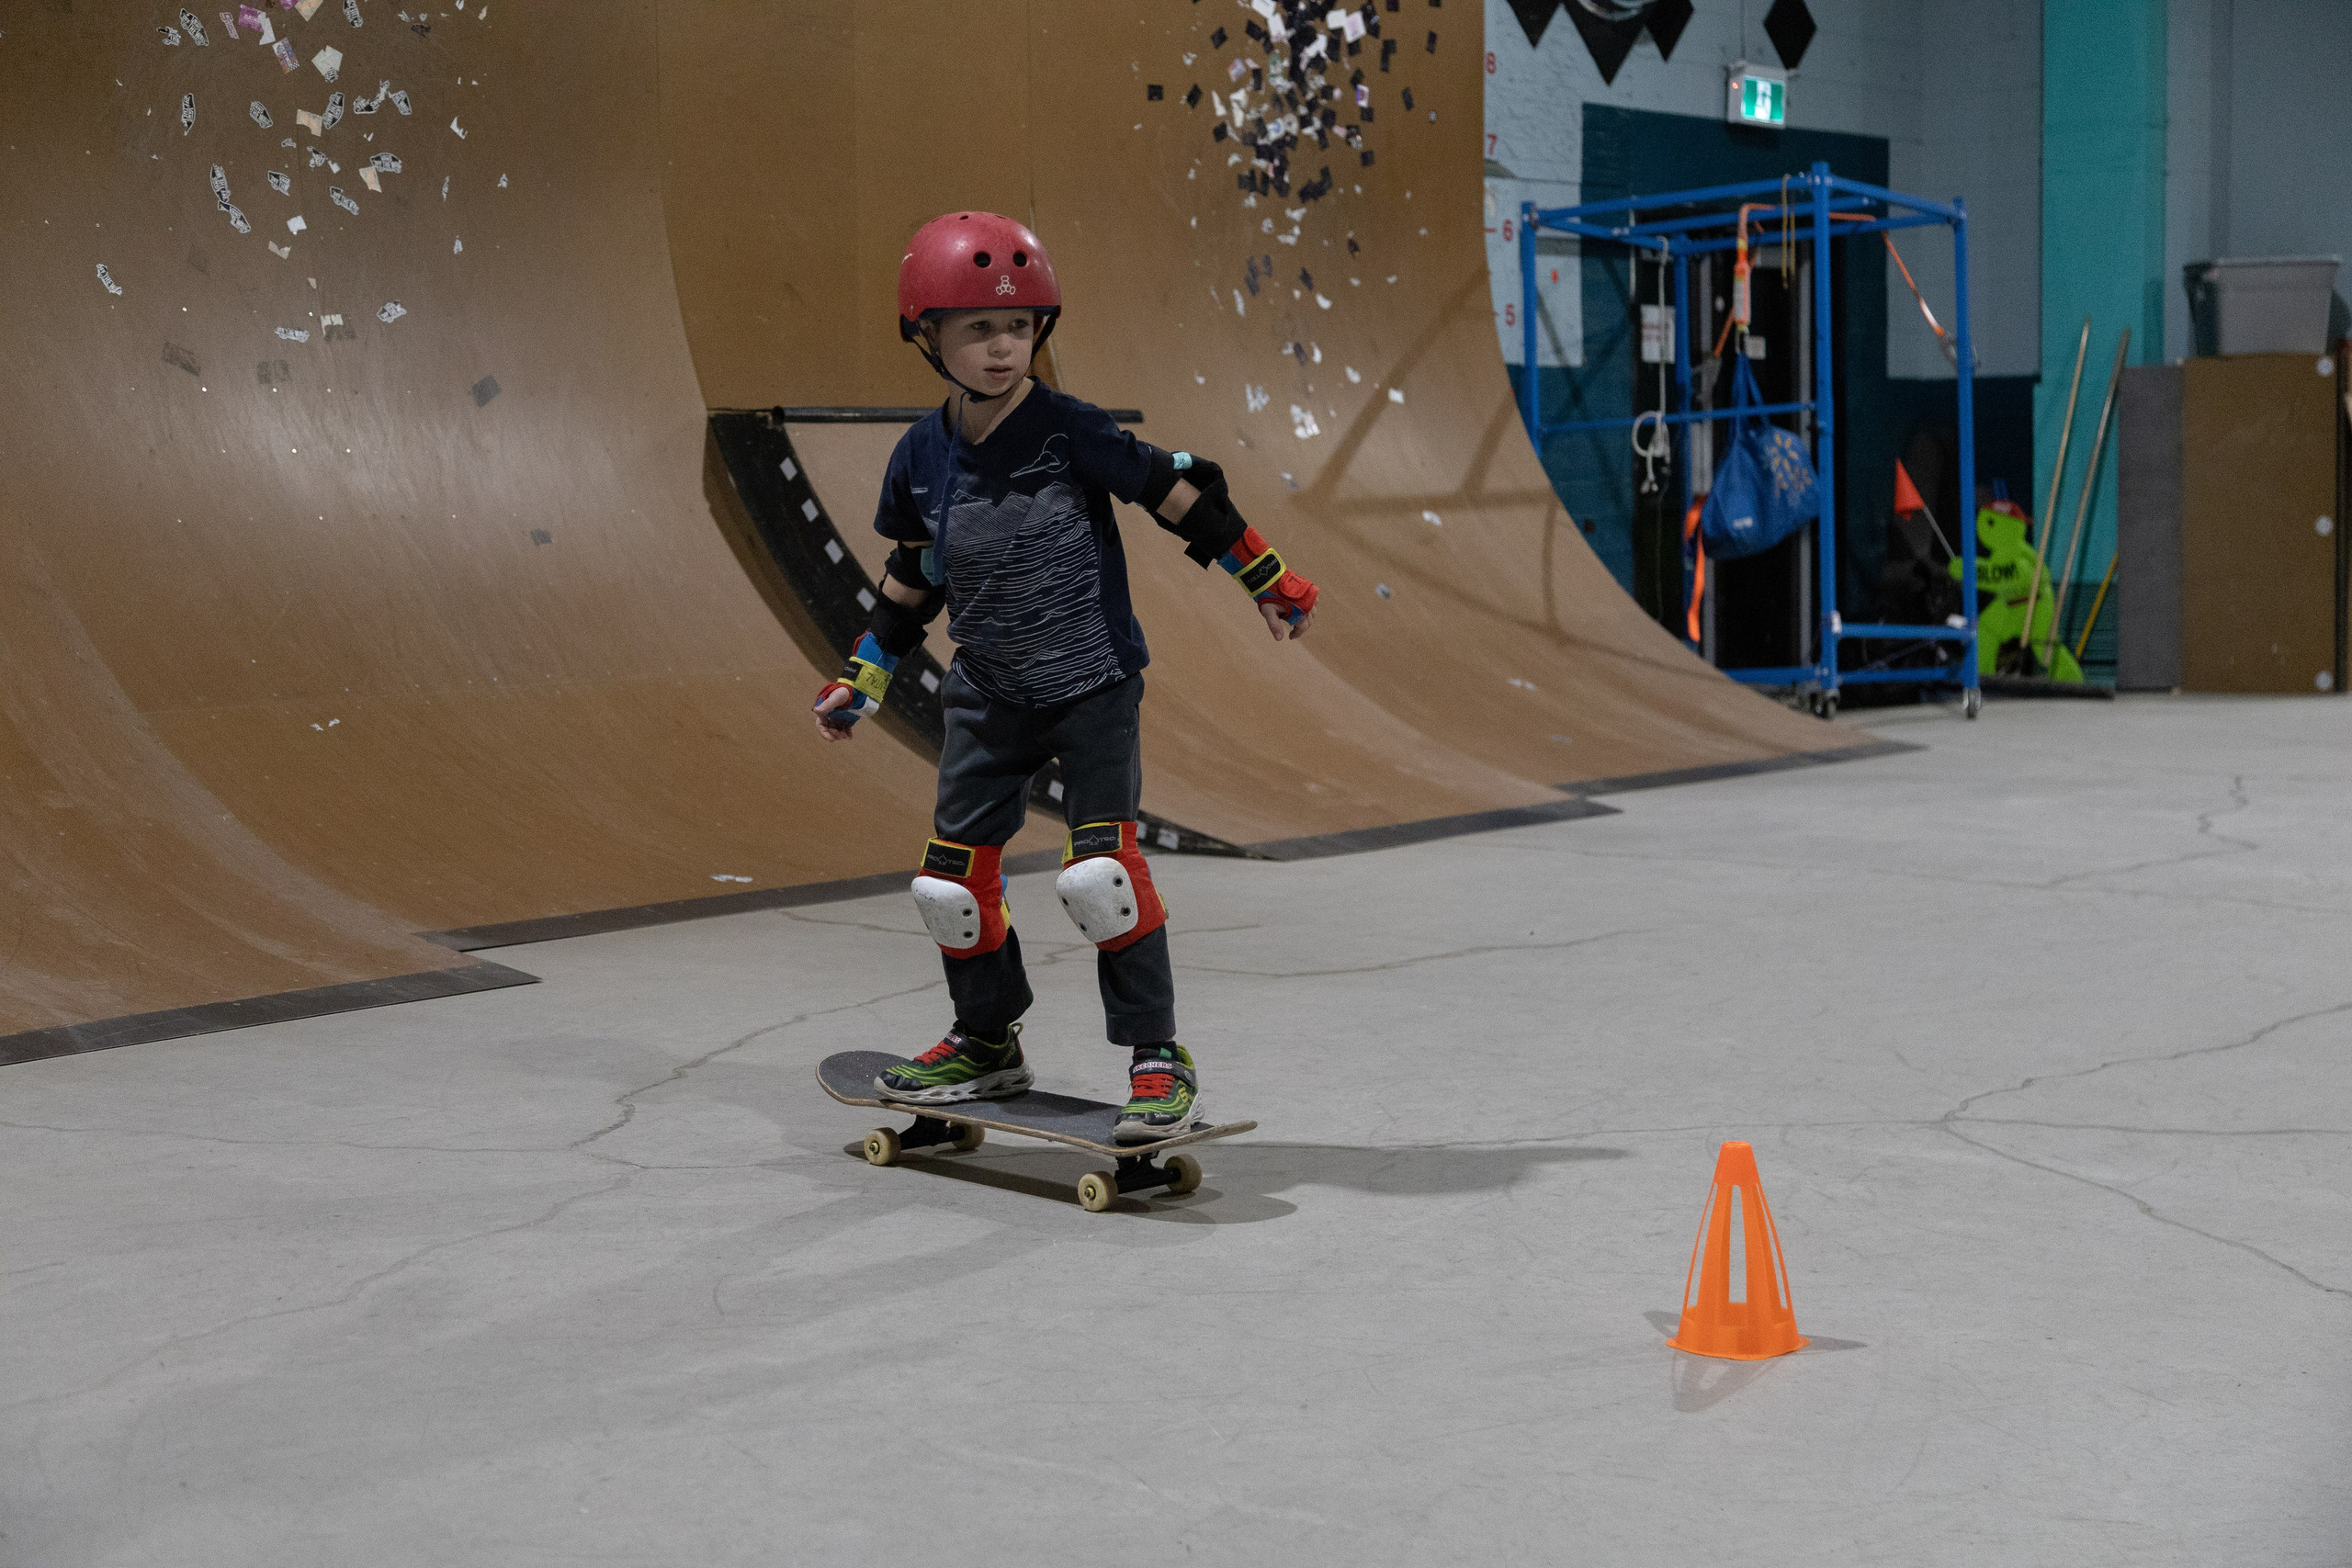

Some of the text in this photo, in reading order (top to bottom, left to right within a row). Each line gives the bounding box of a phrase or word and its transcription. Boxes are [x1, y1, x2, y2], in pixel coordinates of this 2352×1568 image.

[1486, 51, 1497, 74] 8
[1487, 133, 1498, 154] 7
[1503, 220, 1513, 242] 6
[1506, 303, 1516, 326] 5
[946, 858, 963, 866] TEC
[1133, 1061, 1172, 1073] SKECHERS
